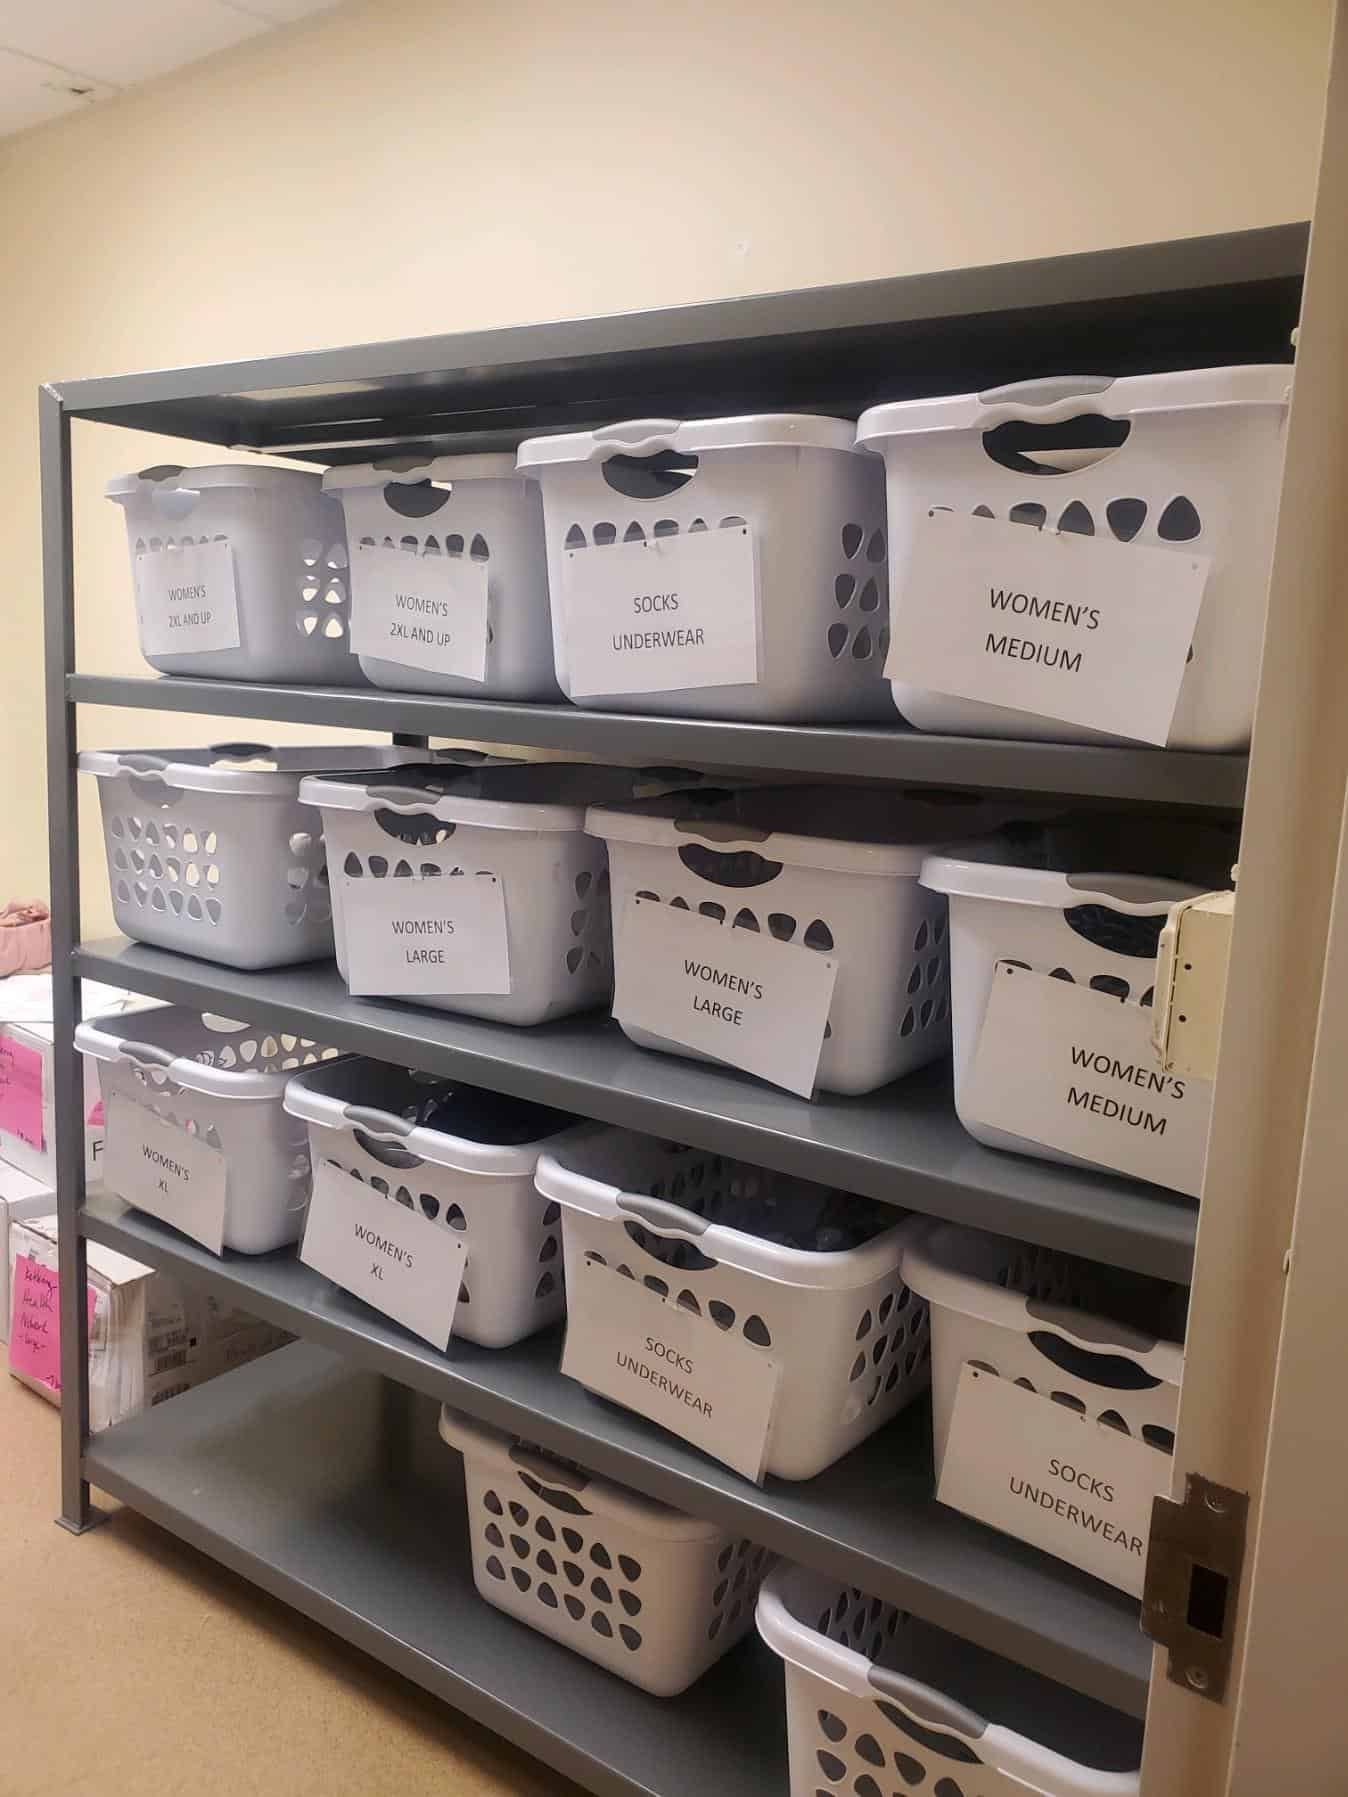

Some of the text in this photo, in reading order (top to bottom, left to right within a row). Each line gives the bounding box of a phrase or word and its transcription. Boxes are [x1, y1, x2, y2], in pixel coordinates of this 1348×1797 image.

[395, 593, 448, 617] WOMEN'S
[632, 592, 680, 614] SOCKS
[988, 587, 1100, 631] WOMEN'S
[390, 622, 450, 647] 2XL AND UP
[611, 626, 705, 652] UNDERWEAR
[984, 632, 1083, 674] MEDIUM
[391, 919, 455, 936] WOMEN'S
[405, 949, 446, 965] LARGE
[683, 959, 764, 1000] WOMEN'S
[692, 994, 744, 1027] LARGE
[1070, 1045, 1186, 1100] WOMEN'S
[1066, 1086, 1167, 1136] MEDIUM
[142, 1143, 191, 1182] WOMEN'S
[157, 1178, 169, 1194] XL
[354, 1223, 415, 1269] WOMEN'S
[370, 1263, 385, 1281] XL
[645, 1337, 694, 1375] SOCKS
[616, 1351, 713, 1419] UNDERWEAR
[1048, 1459, 1115, 1503] SOCKS
[1009, 1476, 1143, 1557] UNDERWEAR
